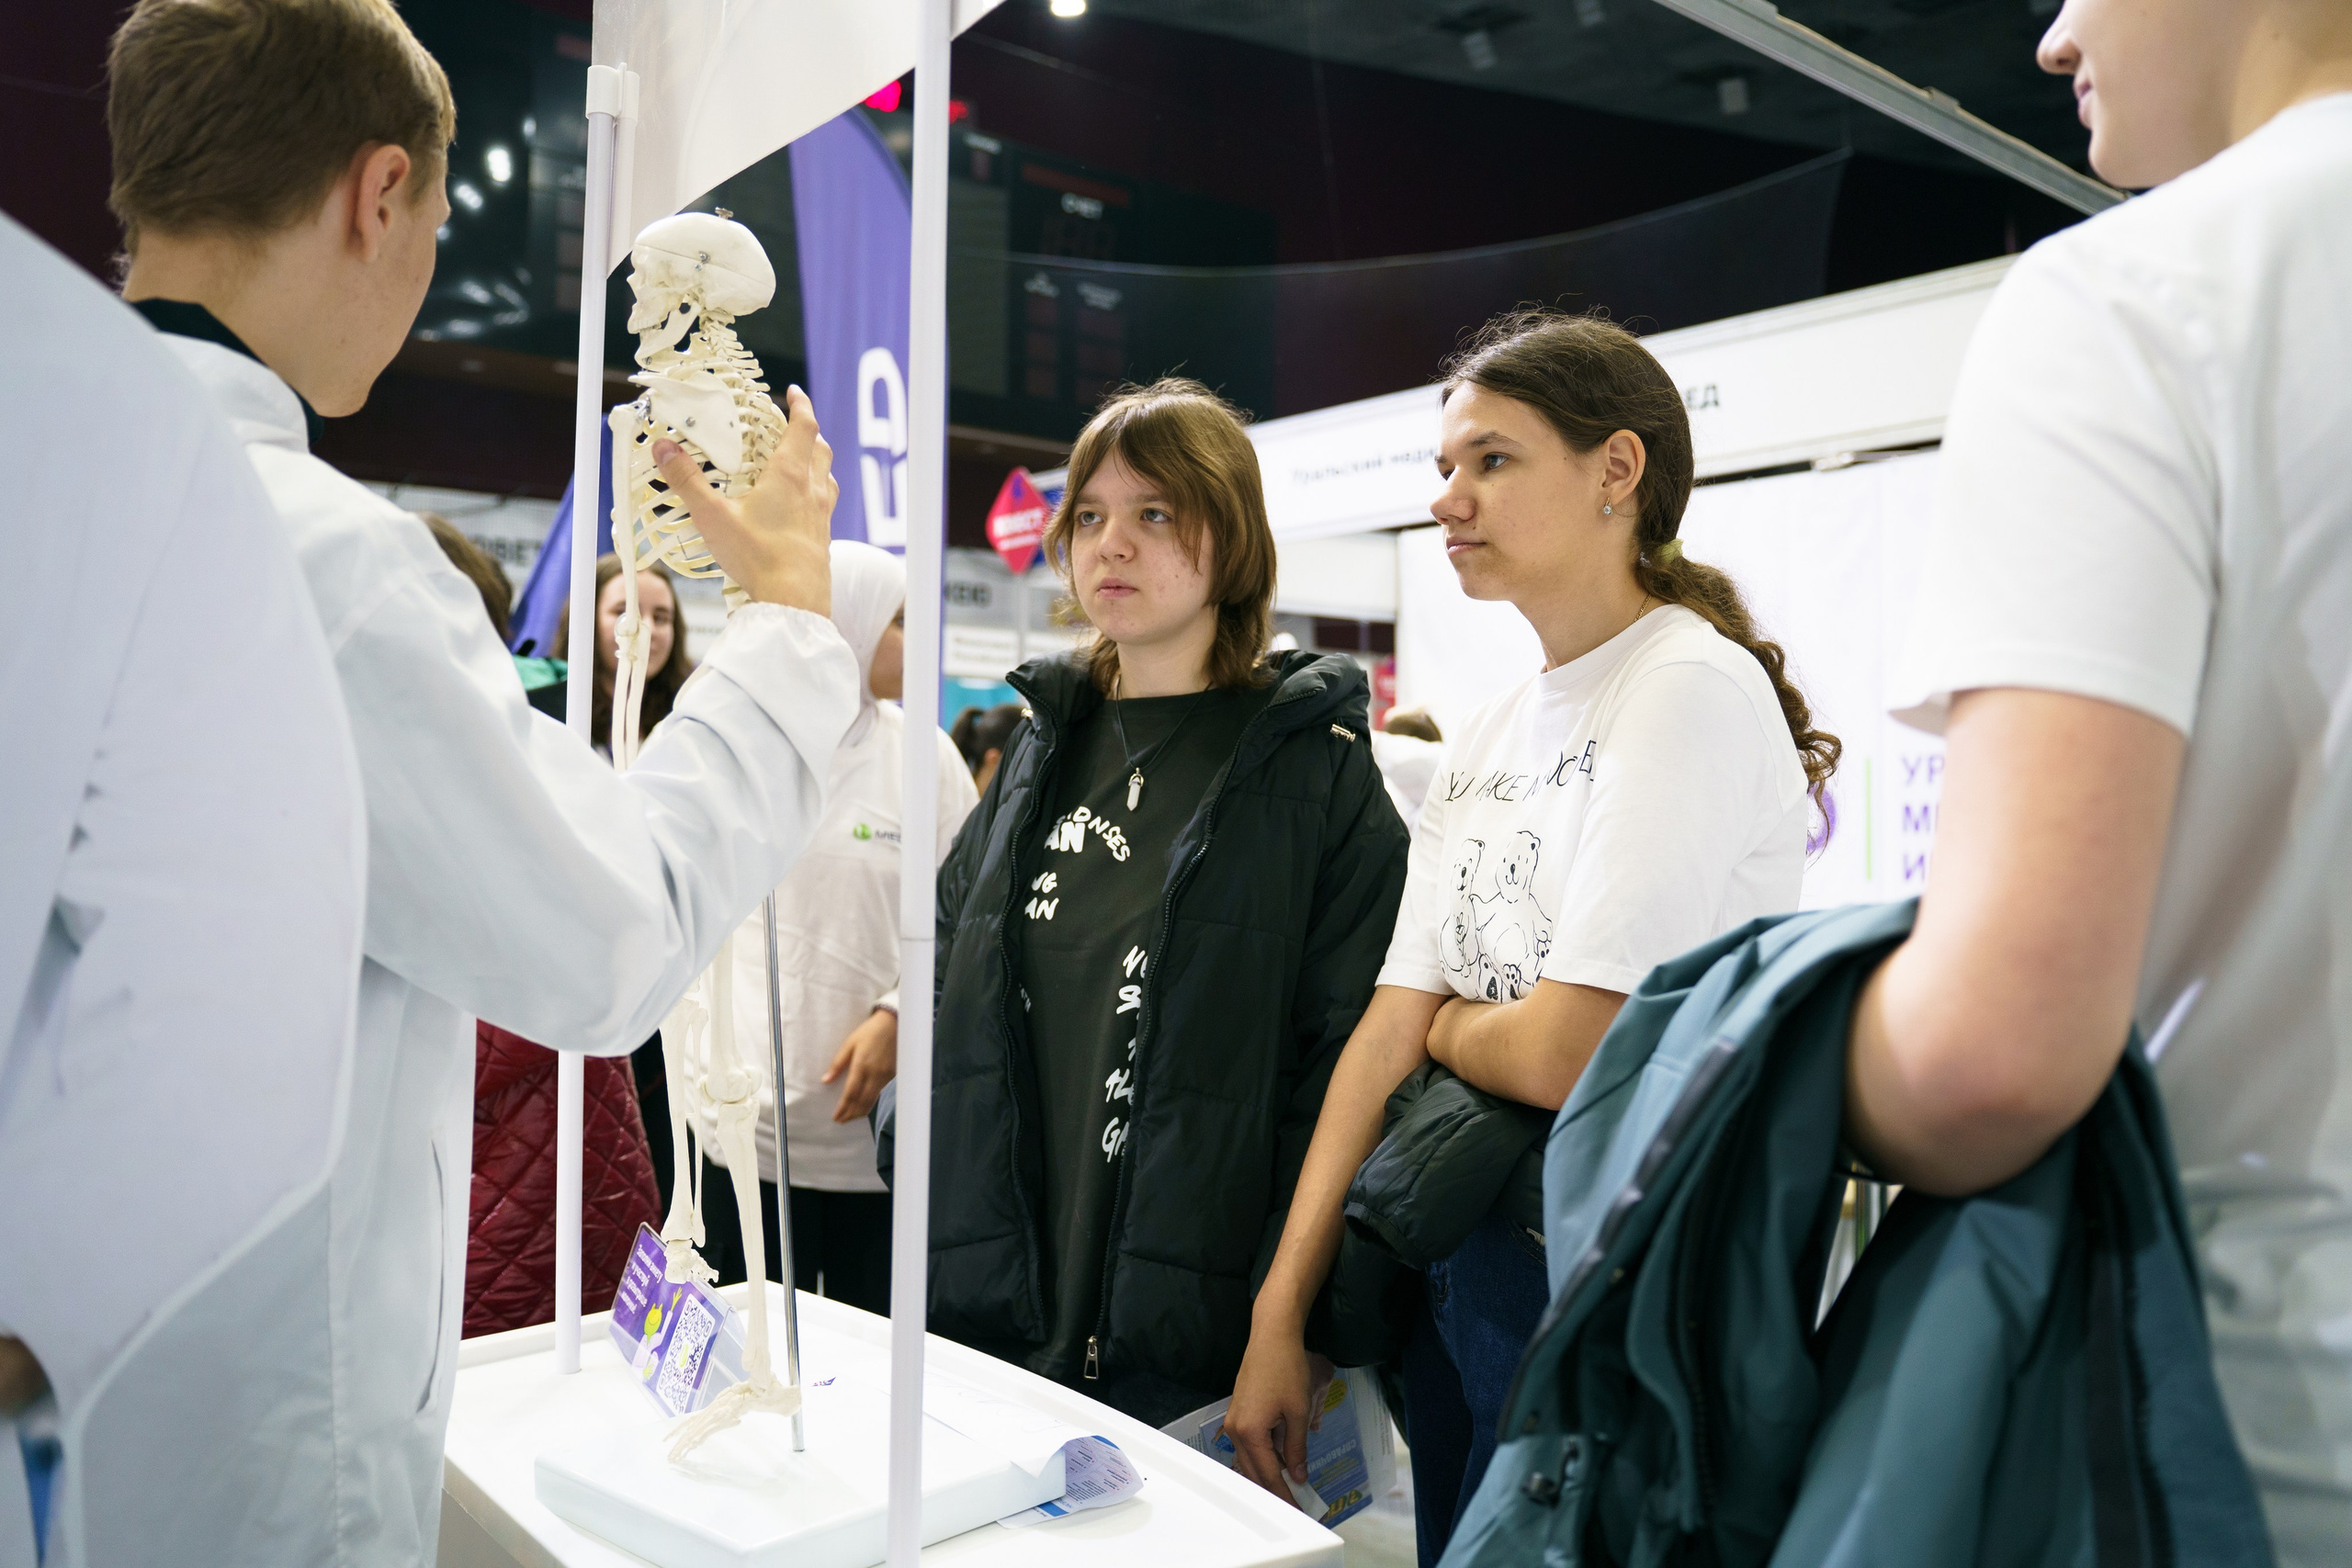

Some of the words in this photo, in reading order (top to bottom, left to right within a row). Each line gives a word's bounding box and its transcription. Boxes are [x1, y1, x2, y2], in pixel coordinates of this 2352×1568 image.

[1685, 384, 1719, 410] ЕД
[1901, 753, 1946, 785] УР
[1045, 820, 1086, 853] AN
[1903, 853, 1926, 882] И
[1024, 897, 1059, 920] AN
